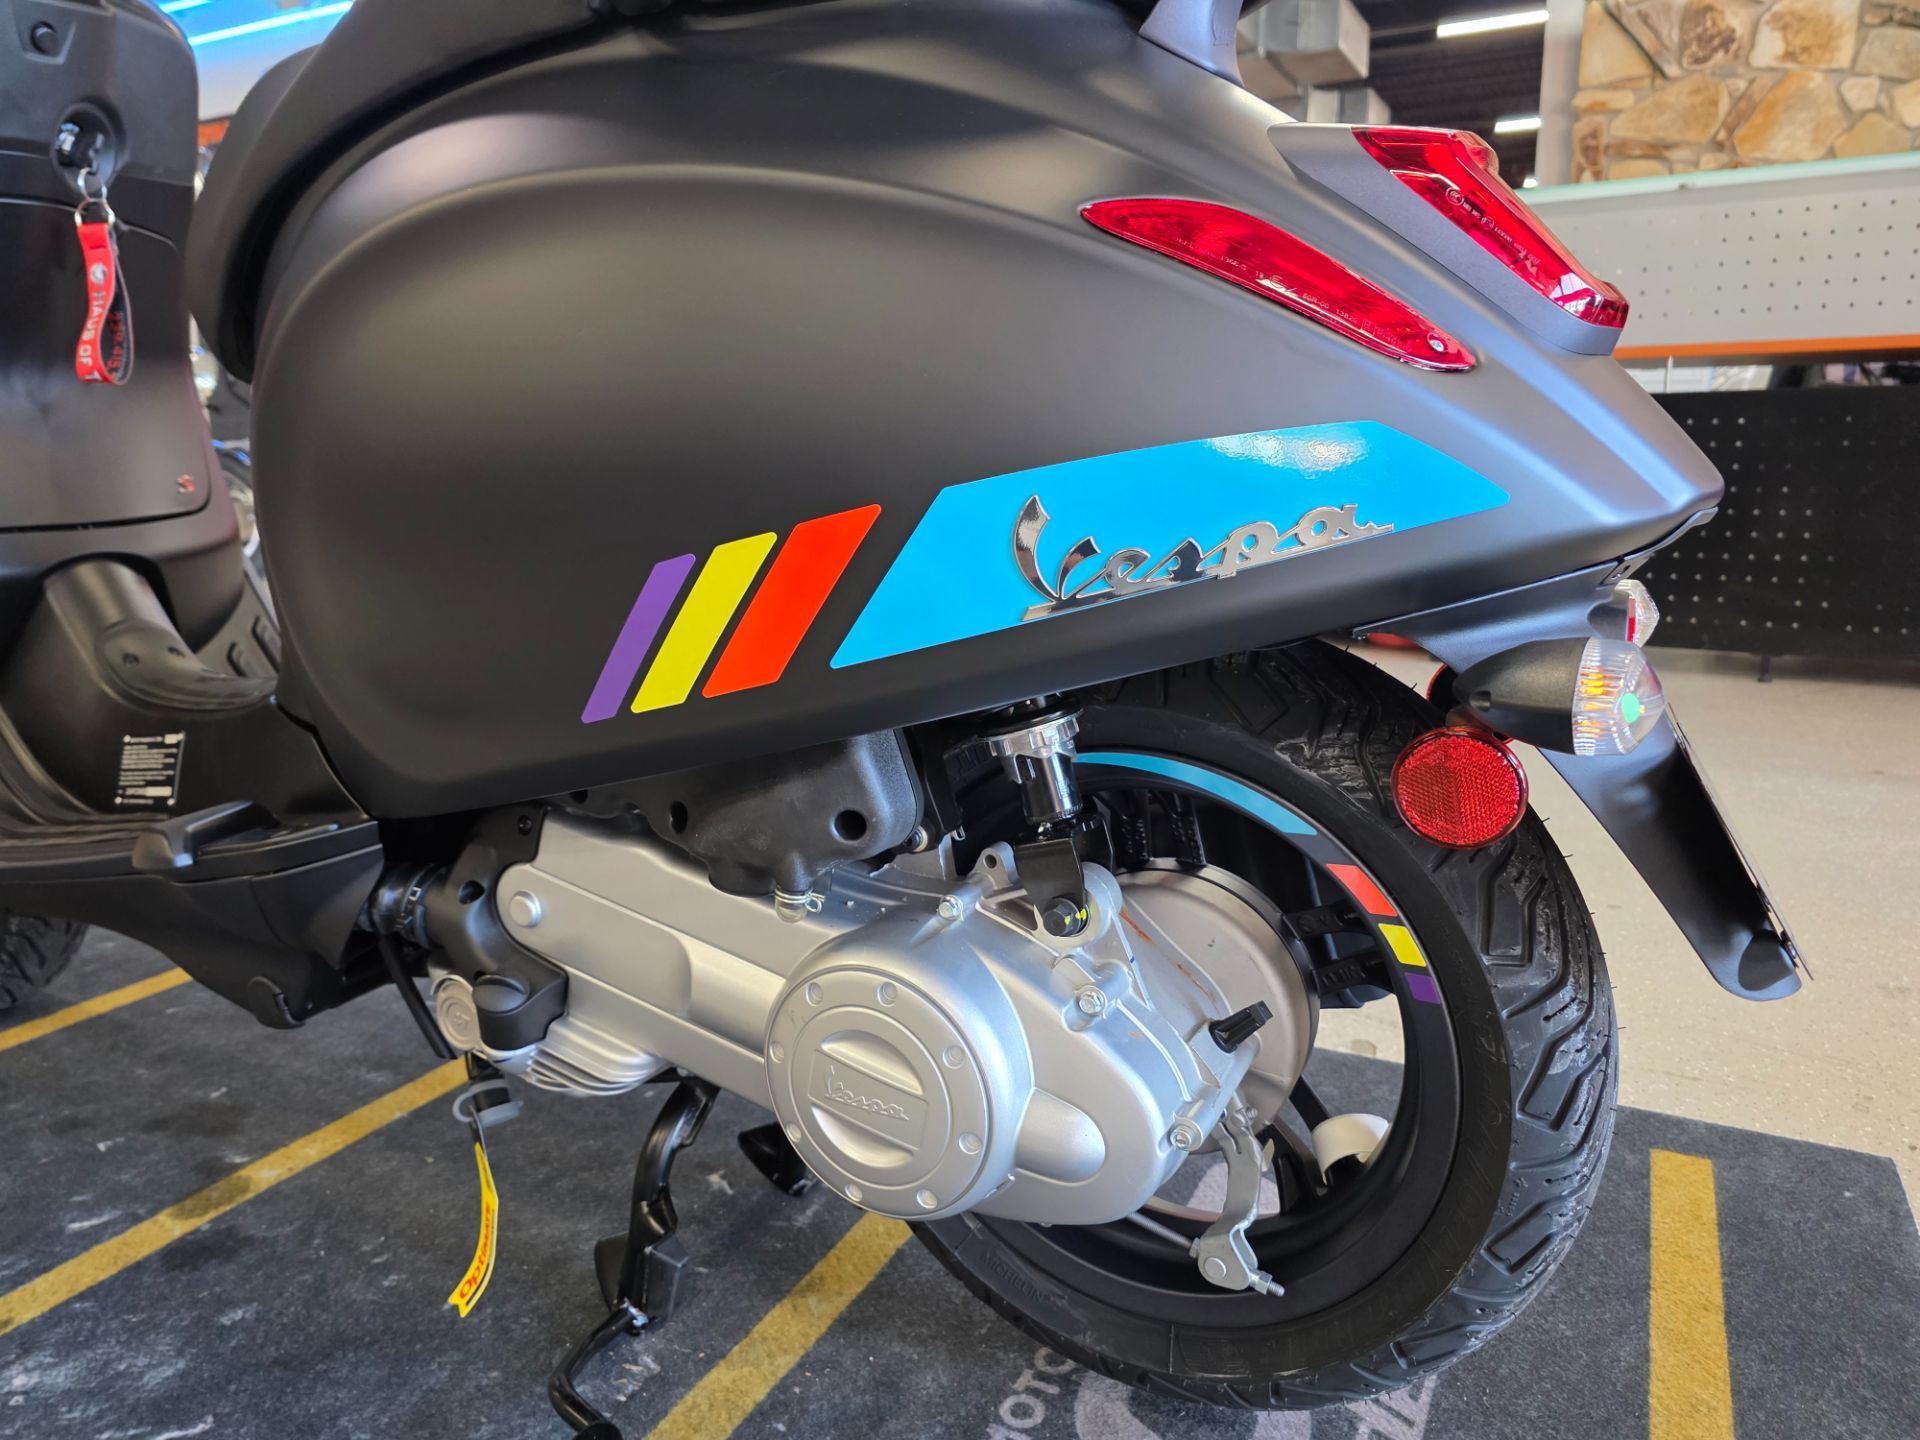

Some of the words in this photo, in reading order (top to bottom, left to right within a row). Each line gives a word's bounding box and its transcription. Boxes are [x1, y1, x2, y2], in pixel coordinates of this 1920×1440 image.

[79, 343, 93, 367] OF
[1013, 494, 1394, 622] Vespa
[824, 1064, 910, 1121] Vespa
